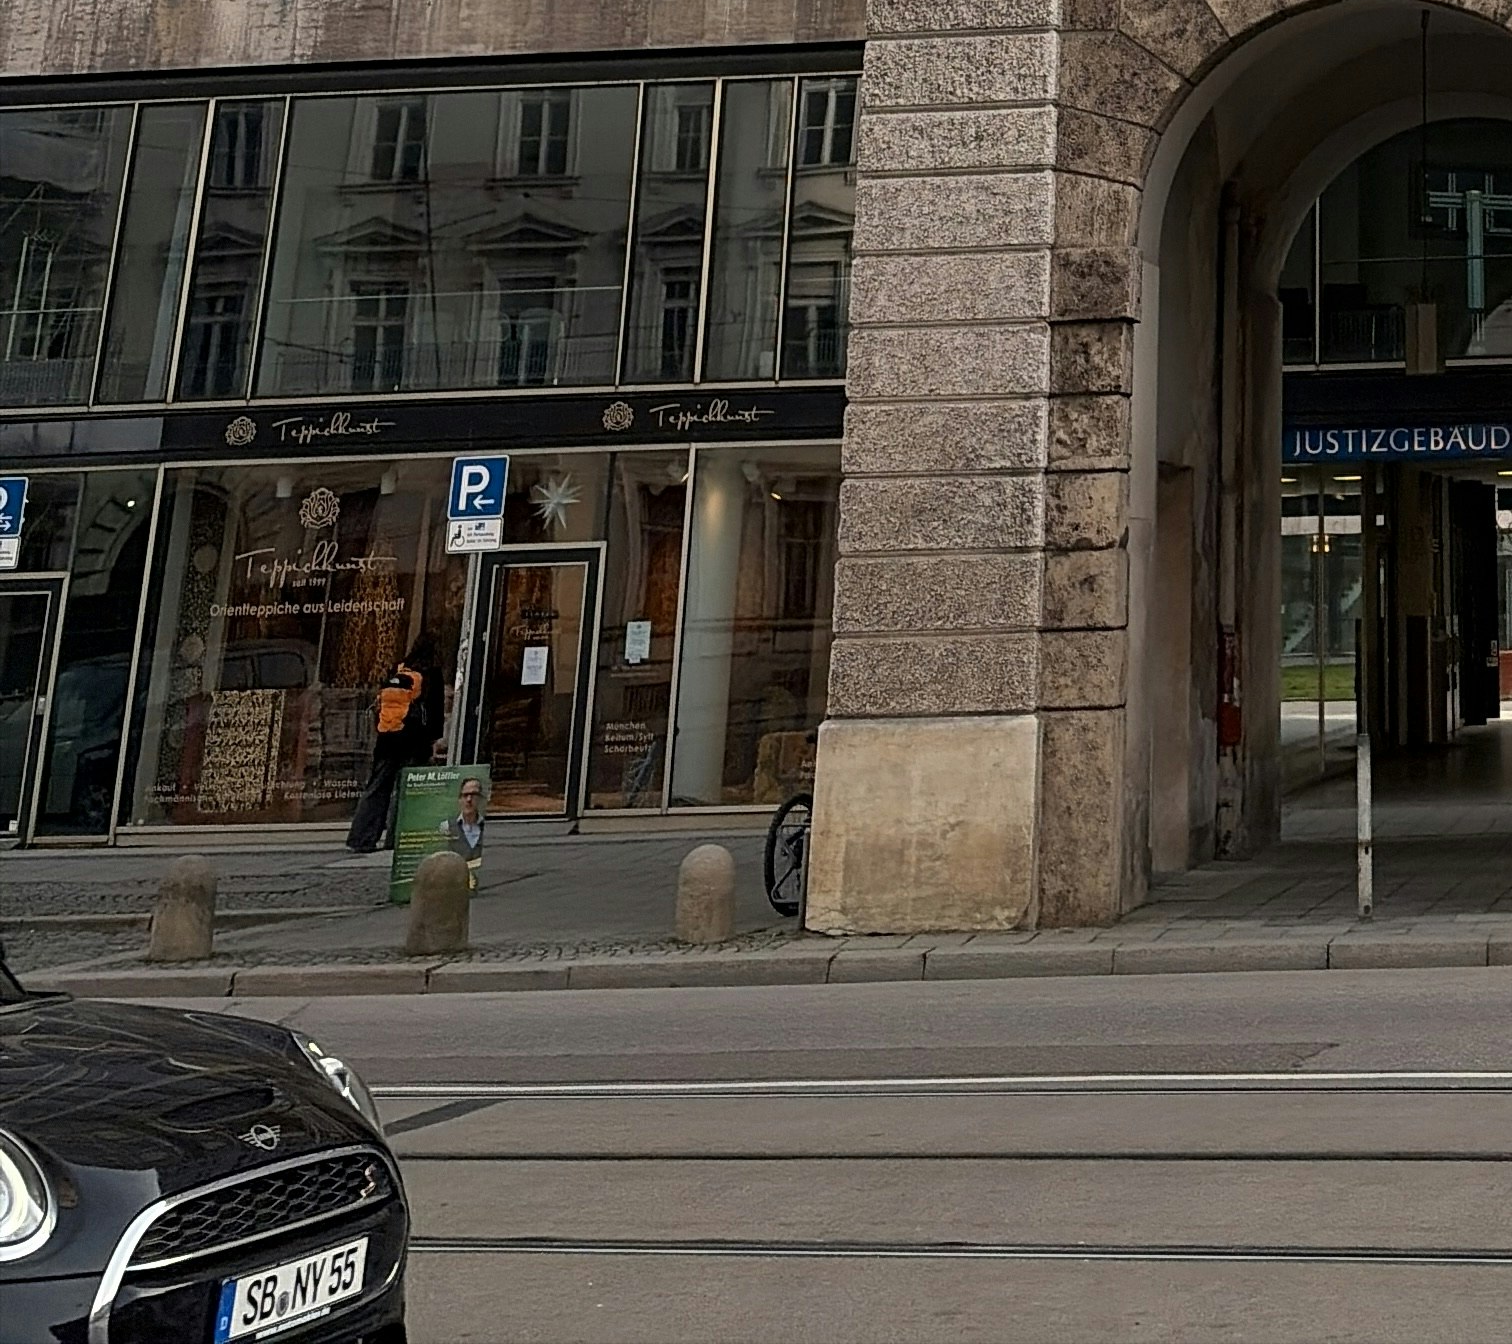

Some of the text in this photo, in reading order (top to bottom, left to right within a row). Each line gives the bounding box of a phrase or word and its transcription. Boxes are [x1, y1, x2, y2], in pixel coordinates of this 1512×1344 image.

[272, 411, 397, 444] Teppichkunst
[650, 398, 775, 430] Teppichkunst
[458, 465, 490, 511] P
[235, 541, 398, 589] Teppichkunst
[209, 598, 405, 618] Orientteppiche aus Leidenschaft
[606, 721, 646, 731] München
[407, 772, 426, 782] Peter
[427, 772, 437, 781] M.
[243, 1274, 278, 1326] SB
[291, 1257, 327, 1310] NY
[328, 1246, 358, 1297] 55
